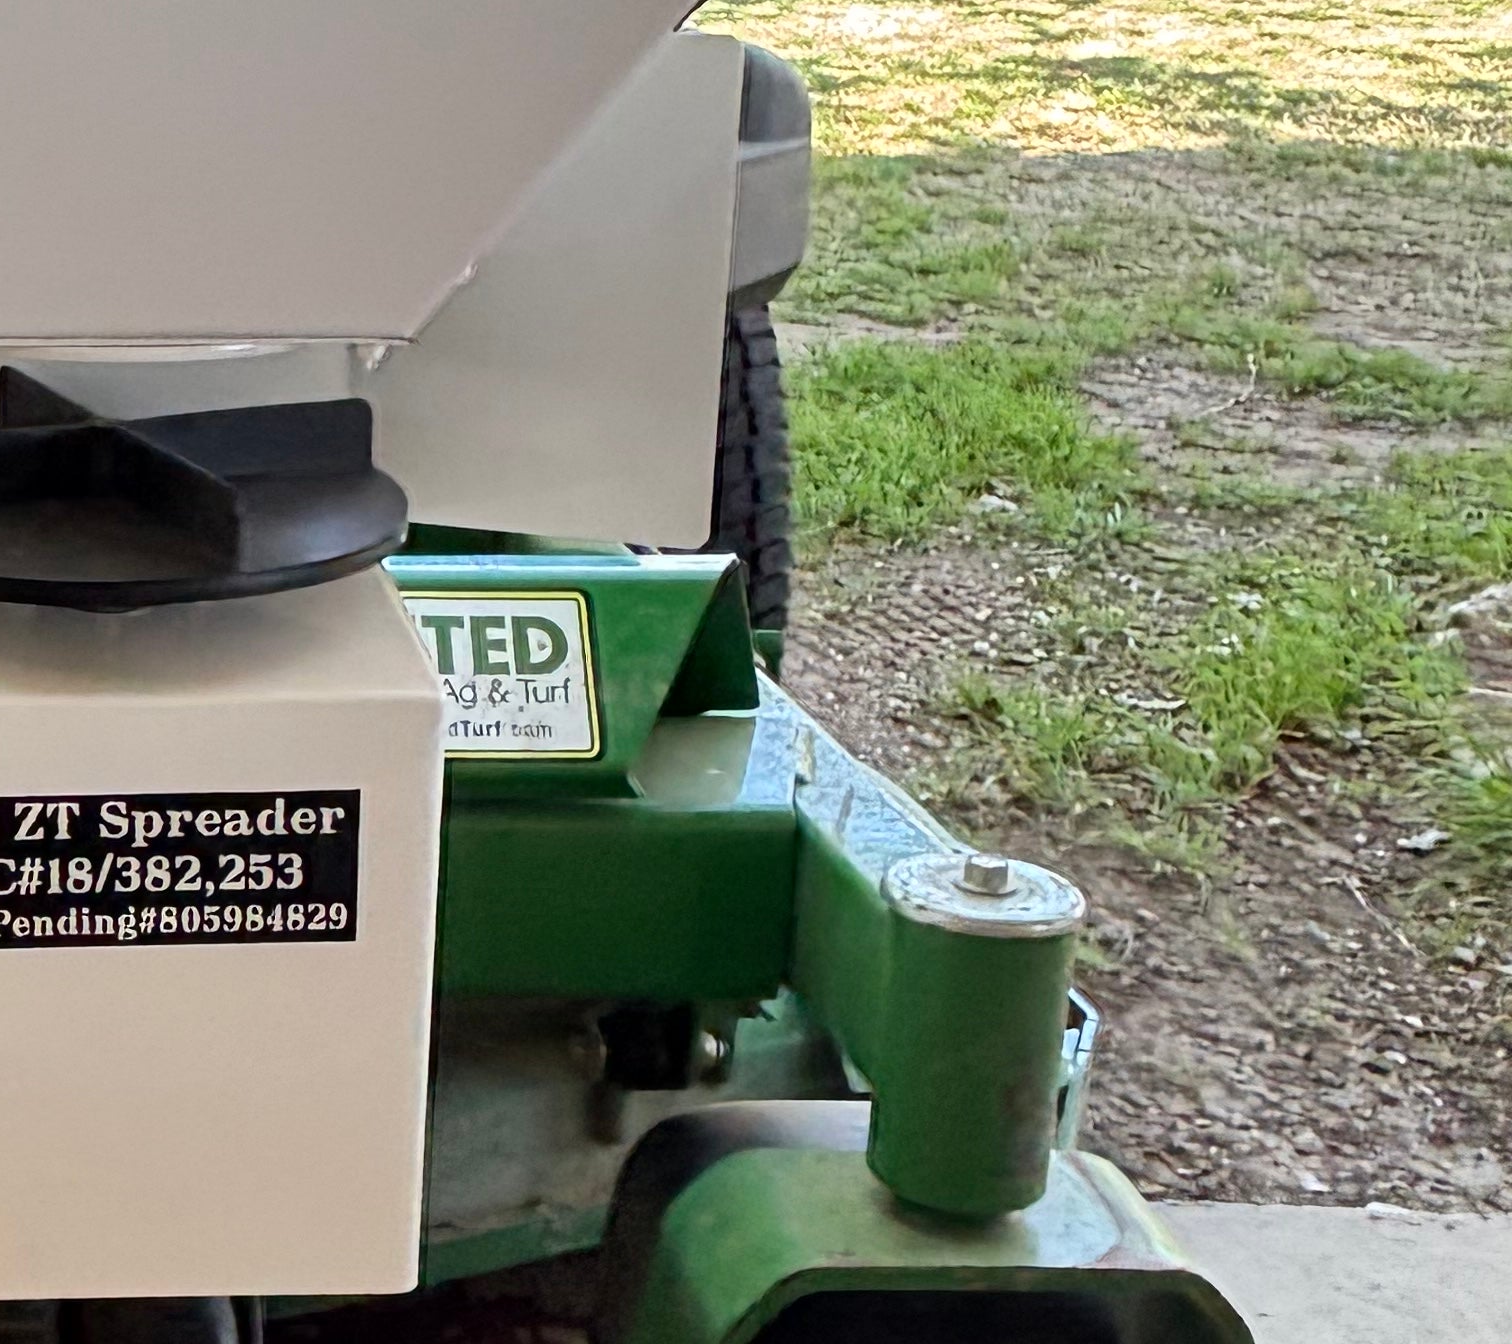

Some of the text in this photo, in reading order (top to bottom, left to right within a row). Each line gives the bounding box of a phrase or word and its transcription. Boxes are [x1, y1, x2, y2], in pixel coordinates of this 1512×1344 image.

[411, 615, 568, 676] TED
[516, 677, 570, 703] Turf
[14, 802, 80, 841] ZT
[98, 797, 346, 848] Spreader
